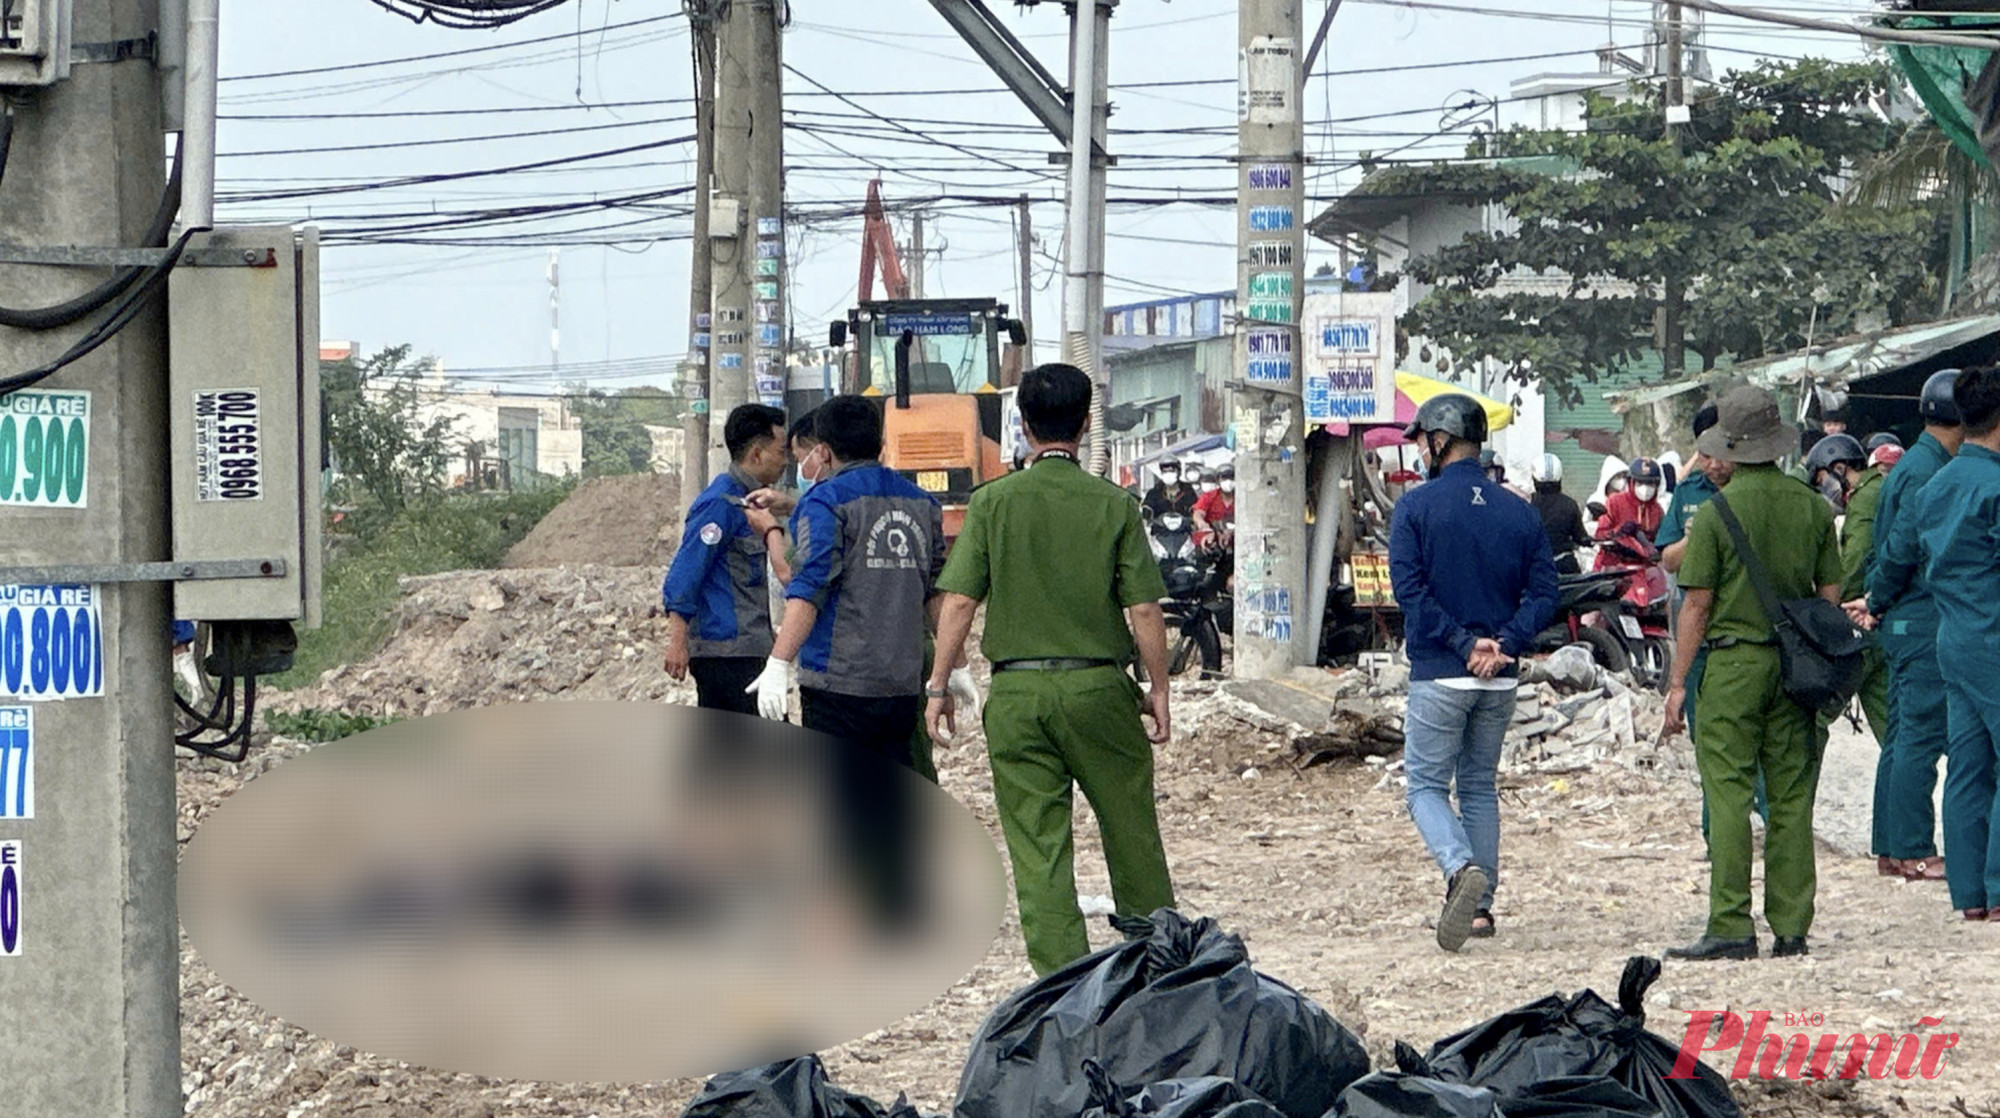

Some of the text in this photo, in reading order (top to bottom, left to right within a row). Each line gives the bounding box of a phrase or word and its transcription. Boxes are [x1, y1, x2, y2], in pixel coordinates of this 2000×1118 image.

[14, 395, 53, 413] GIÁ
[218, 393, 259, 498] 0968.555.700
[19, 585, 57, 604] GIÁ
